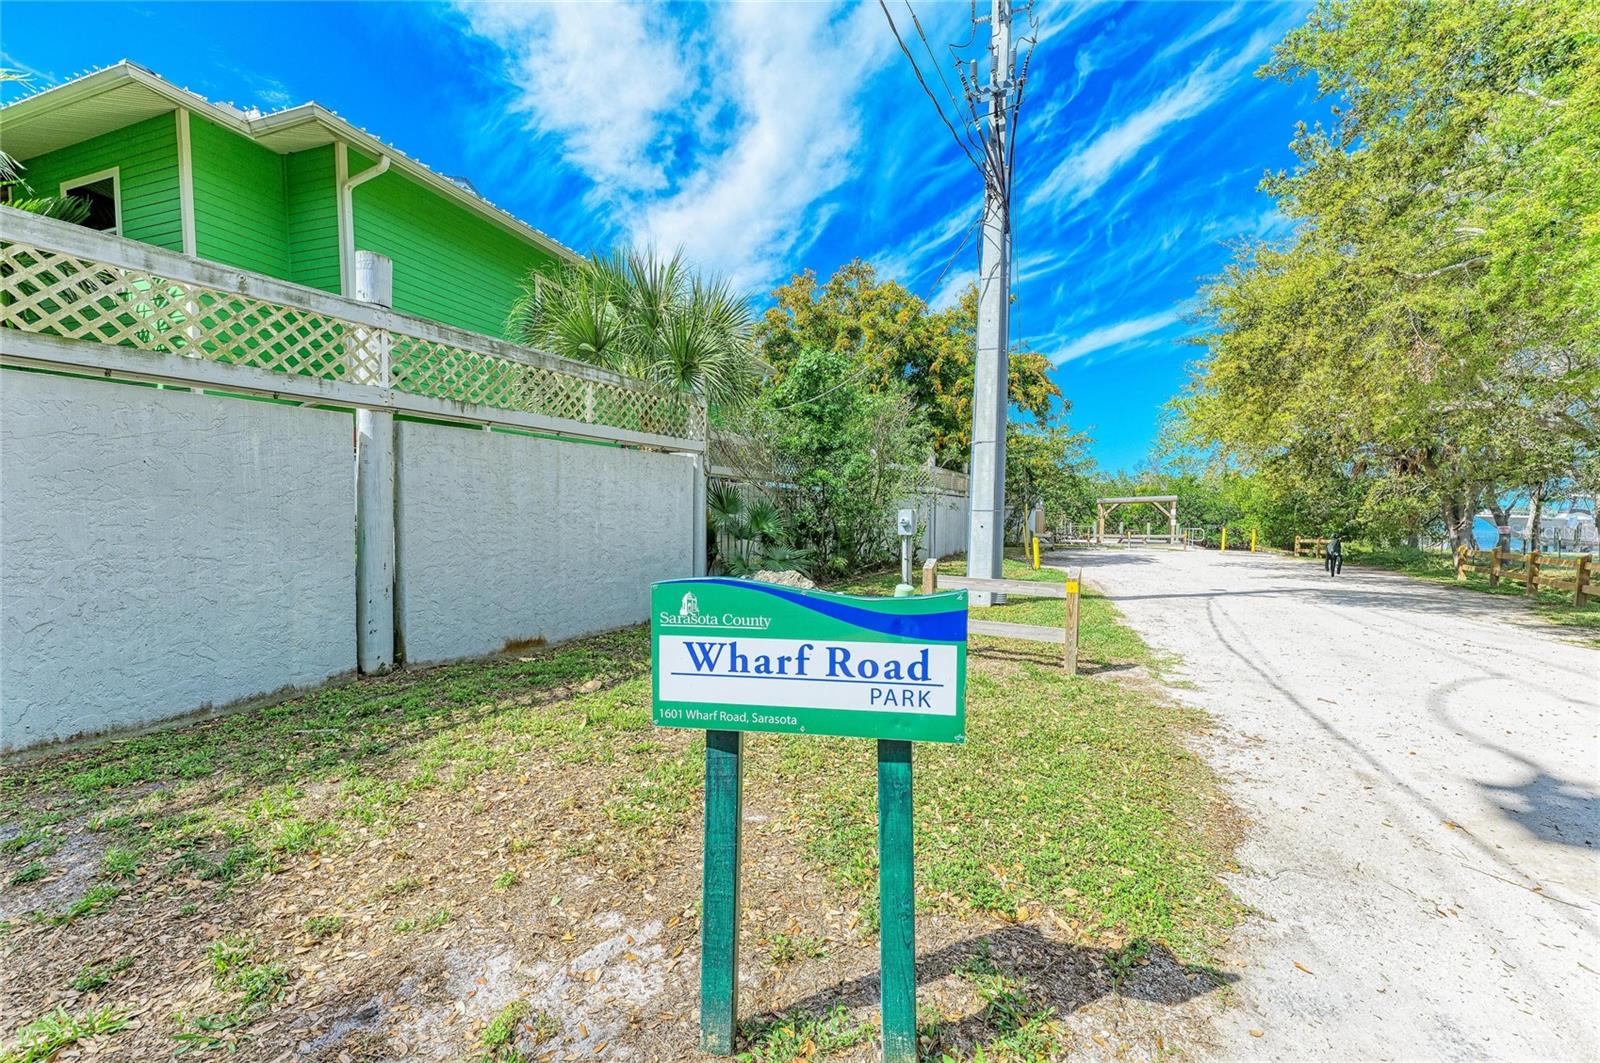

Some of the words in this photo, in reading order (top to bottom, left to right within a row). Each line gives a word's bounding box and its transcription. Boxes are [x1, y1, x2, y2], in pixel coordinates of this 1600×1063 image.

[660, 611, 718, 627] Sarasota
[722, 613, 772, 630] County
[683, 641, 814, 676] Wharf
[826, 646, 932, 682] Road
[870, 687, 932, 708] PARK
[659, 708, 683, 719] 1601
[686, 709, 717, 721] Wharf
[720, 711, 749, 724] Road,
[752, 713, 797, 726] Sarasota
